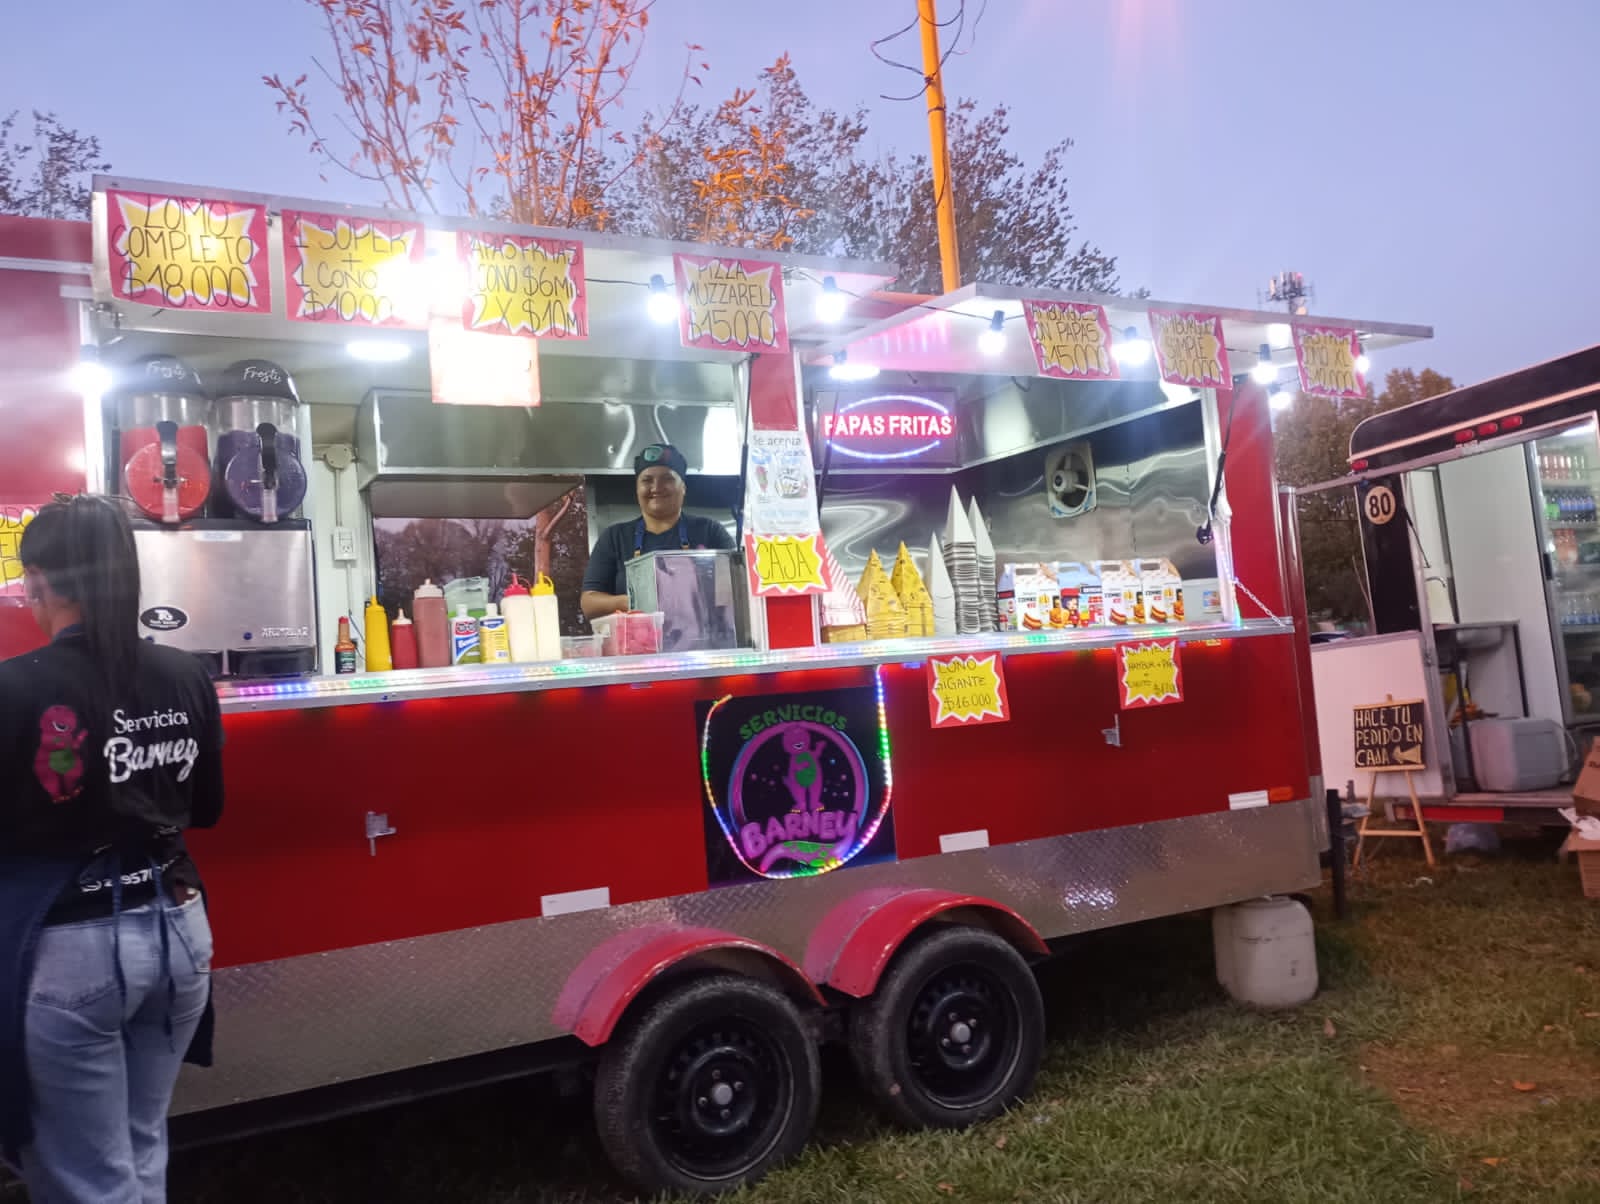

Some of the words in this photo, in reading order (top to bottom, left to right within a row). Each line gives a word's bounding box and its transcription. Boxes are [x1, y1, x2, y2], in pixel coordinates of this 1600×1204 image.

[144, 195, 229, 237] LOMO
[112, 224, 254, 264] COMPLETO
[295, 261, 310, 287] 1
[889, 415, 952, 436] FRITAS
[1369, 491, 1391, 518] 80
[756, 541, 813, 581] CAJA
[113, 708, 189, 734] Servicios
[739, 704, 848, 740] SERVICIOS
[1355, 707, 1388, 728] HACE
[1391, 705, 1411, 725] TU
[1356, 726, 1402, 748] PEDIDO
[1406, 723, 1423, 744] EN
[103, 737, 199, 783] Barney
[1355, 747, 1390, 766] CAJA
[741, 809, 858, 862] BARNEY
